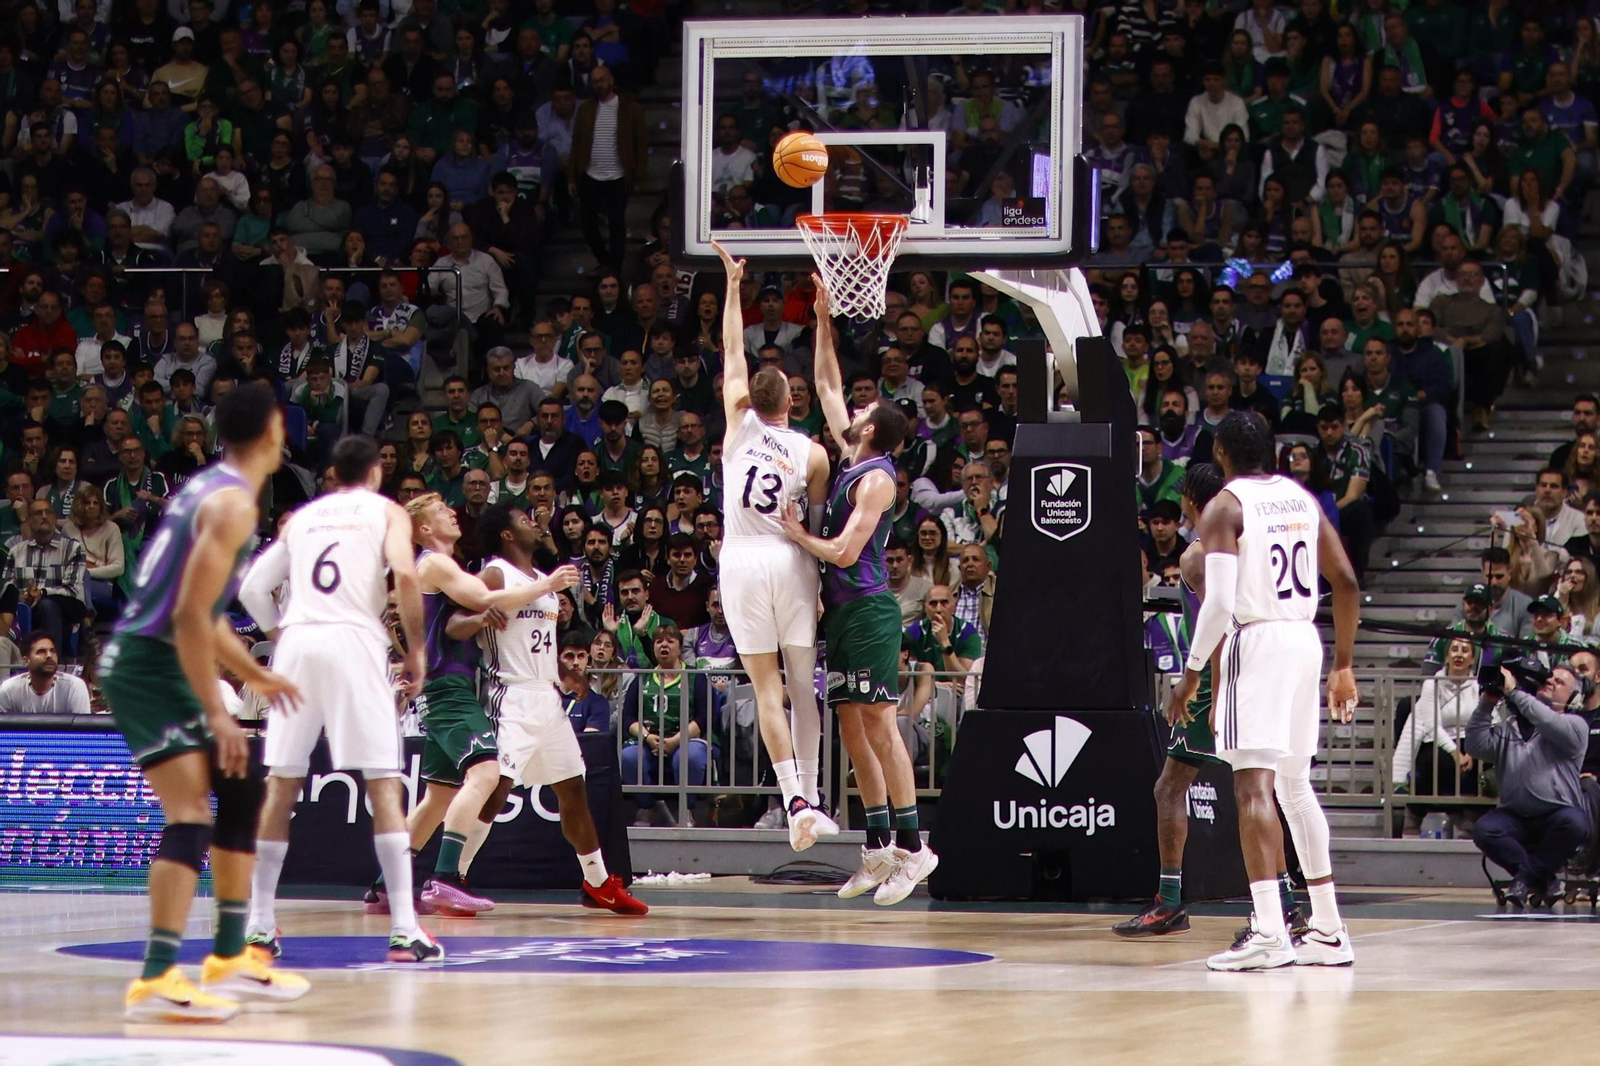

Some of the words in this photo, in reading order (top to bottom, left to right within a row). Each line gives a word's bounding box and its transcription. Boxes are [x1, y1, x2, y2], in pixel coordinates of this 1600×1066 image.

[1003, 206, 1022, 217] liga
[1003, 215, 1044, 225] endesa
[762, 434, 789, 458] MUSA
[746, 449, 794, 475] AUTOHERO
[742, 465, 782, 514] 13
[1041, 499, 1081, 508] Fundación
[1046, 509, 1076, 518] Unicaja
[1255, 499, 1307, 516] FERNANDO
[1267, 523, 1309, 534] AUTOHERO
[312, 541, 341, 595] 6
[1270, 541, 1311, 600] 20
[531, 629, 552, 654] 24
[993, 797, 1116, 836] Unicaja
